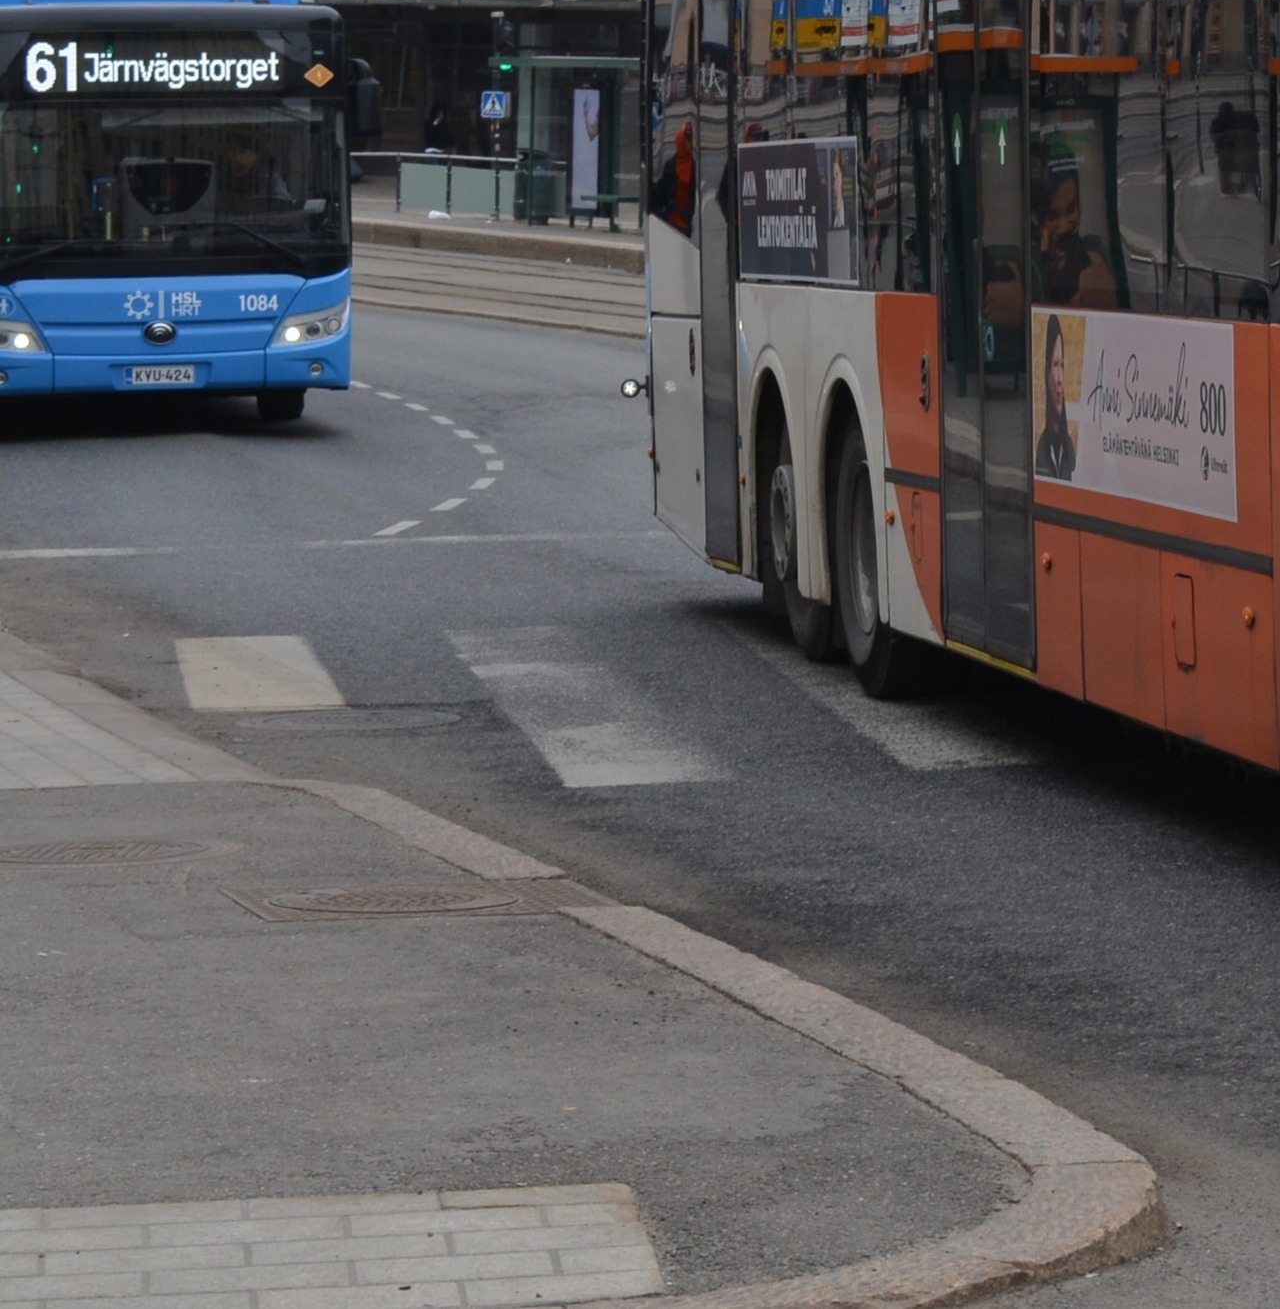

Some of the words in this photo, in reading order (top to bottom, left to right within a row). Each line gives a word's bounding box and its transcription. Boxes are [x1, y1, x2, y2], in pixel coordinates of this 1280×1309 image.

[26, 42, 77, 92] 61
[84, 52, 279, 88] Järnvägstorget
[765, 167, 807, 202] TOIMITILAT
[171, 292, 202, 304] HSL
[238, 294, 279, 312] 1084
[171, 304, 202, 317] HRT
[1200, 381, 1227, 437] 800
[1153, 444, 1180, 466] HELSINKI
